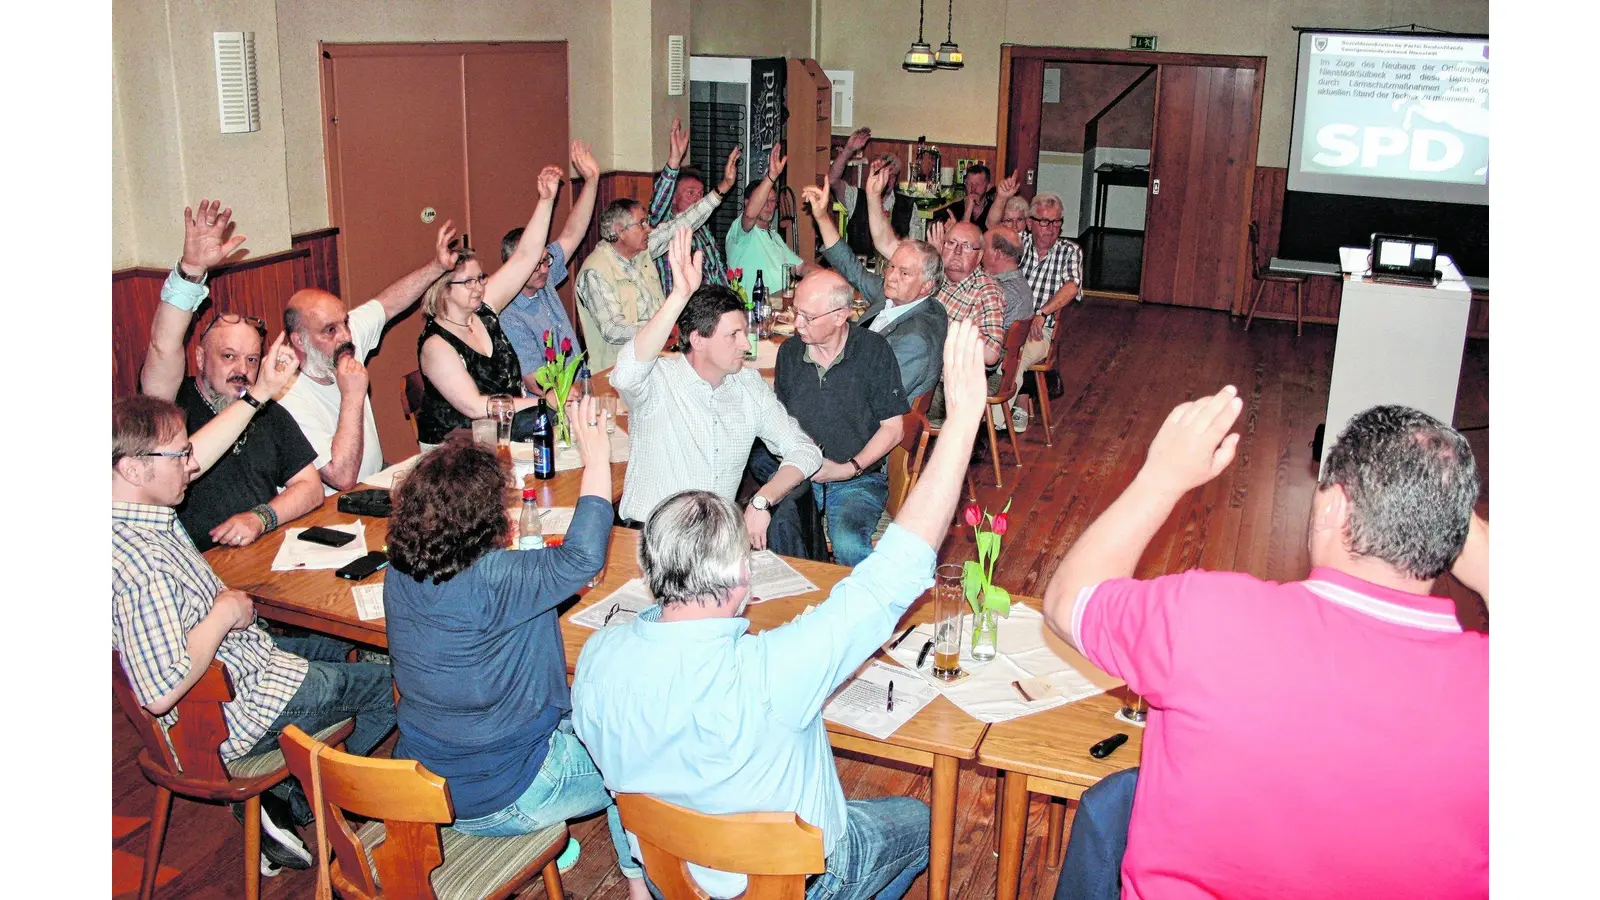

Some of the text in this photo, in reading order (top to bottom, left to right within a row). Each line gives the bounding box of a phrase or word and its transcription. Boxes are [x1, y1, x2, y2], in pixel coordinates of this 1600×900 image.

[1319, 59, 1330, 67] Im
[1336, 59, 1355, 68] Zuge
[1381, 61, 1416, 70] Neubaus
[1422, 63, 1435, 71] der
[1395, 72, 1412, 80] sind
[1318, 78, 1340, 87] durch
[1348, 80, 1440, 91] Lärmschutzmaßnahmen
[1317, 88, 1351, 97] aktuellen
[1353, 89, 1375, 98] Stand
[1376, 90, 1389, 99] der
[1312, 123, 1465, 172] SPD
